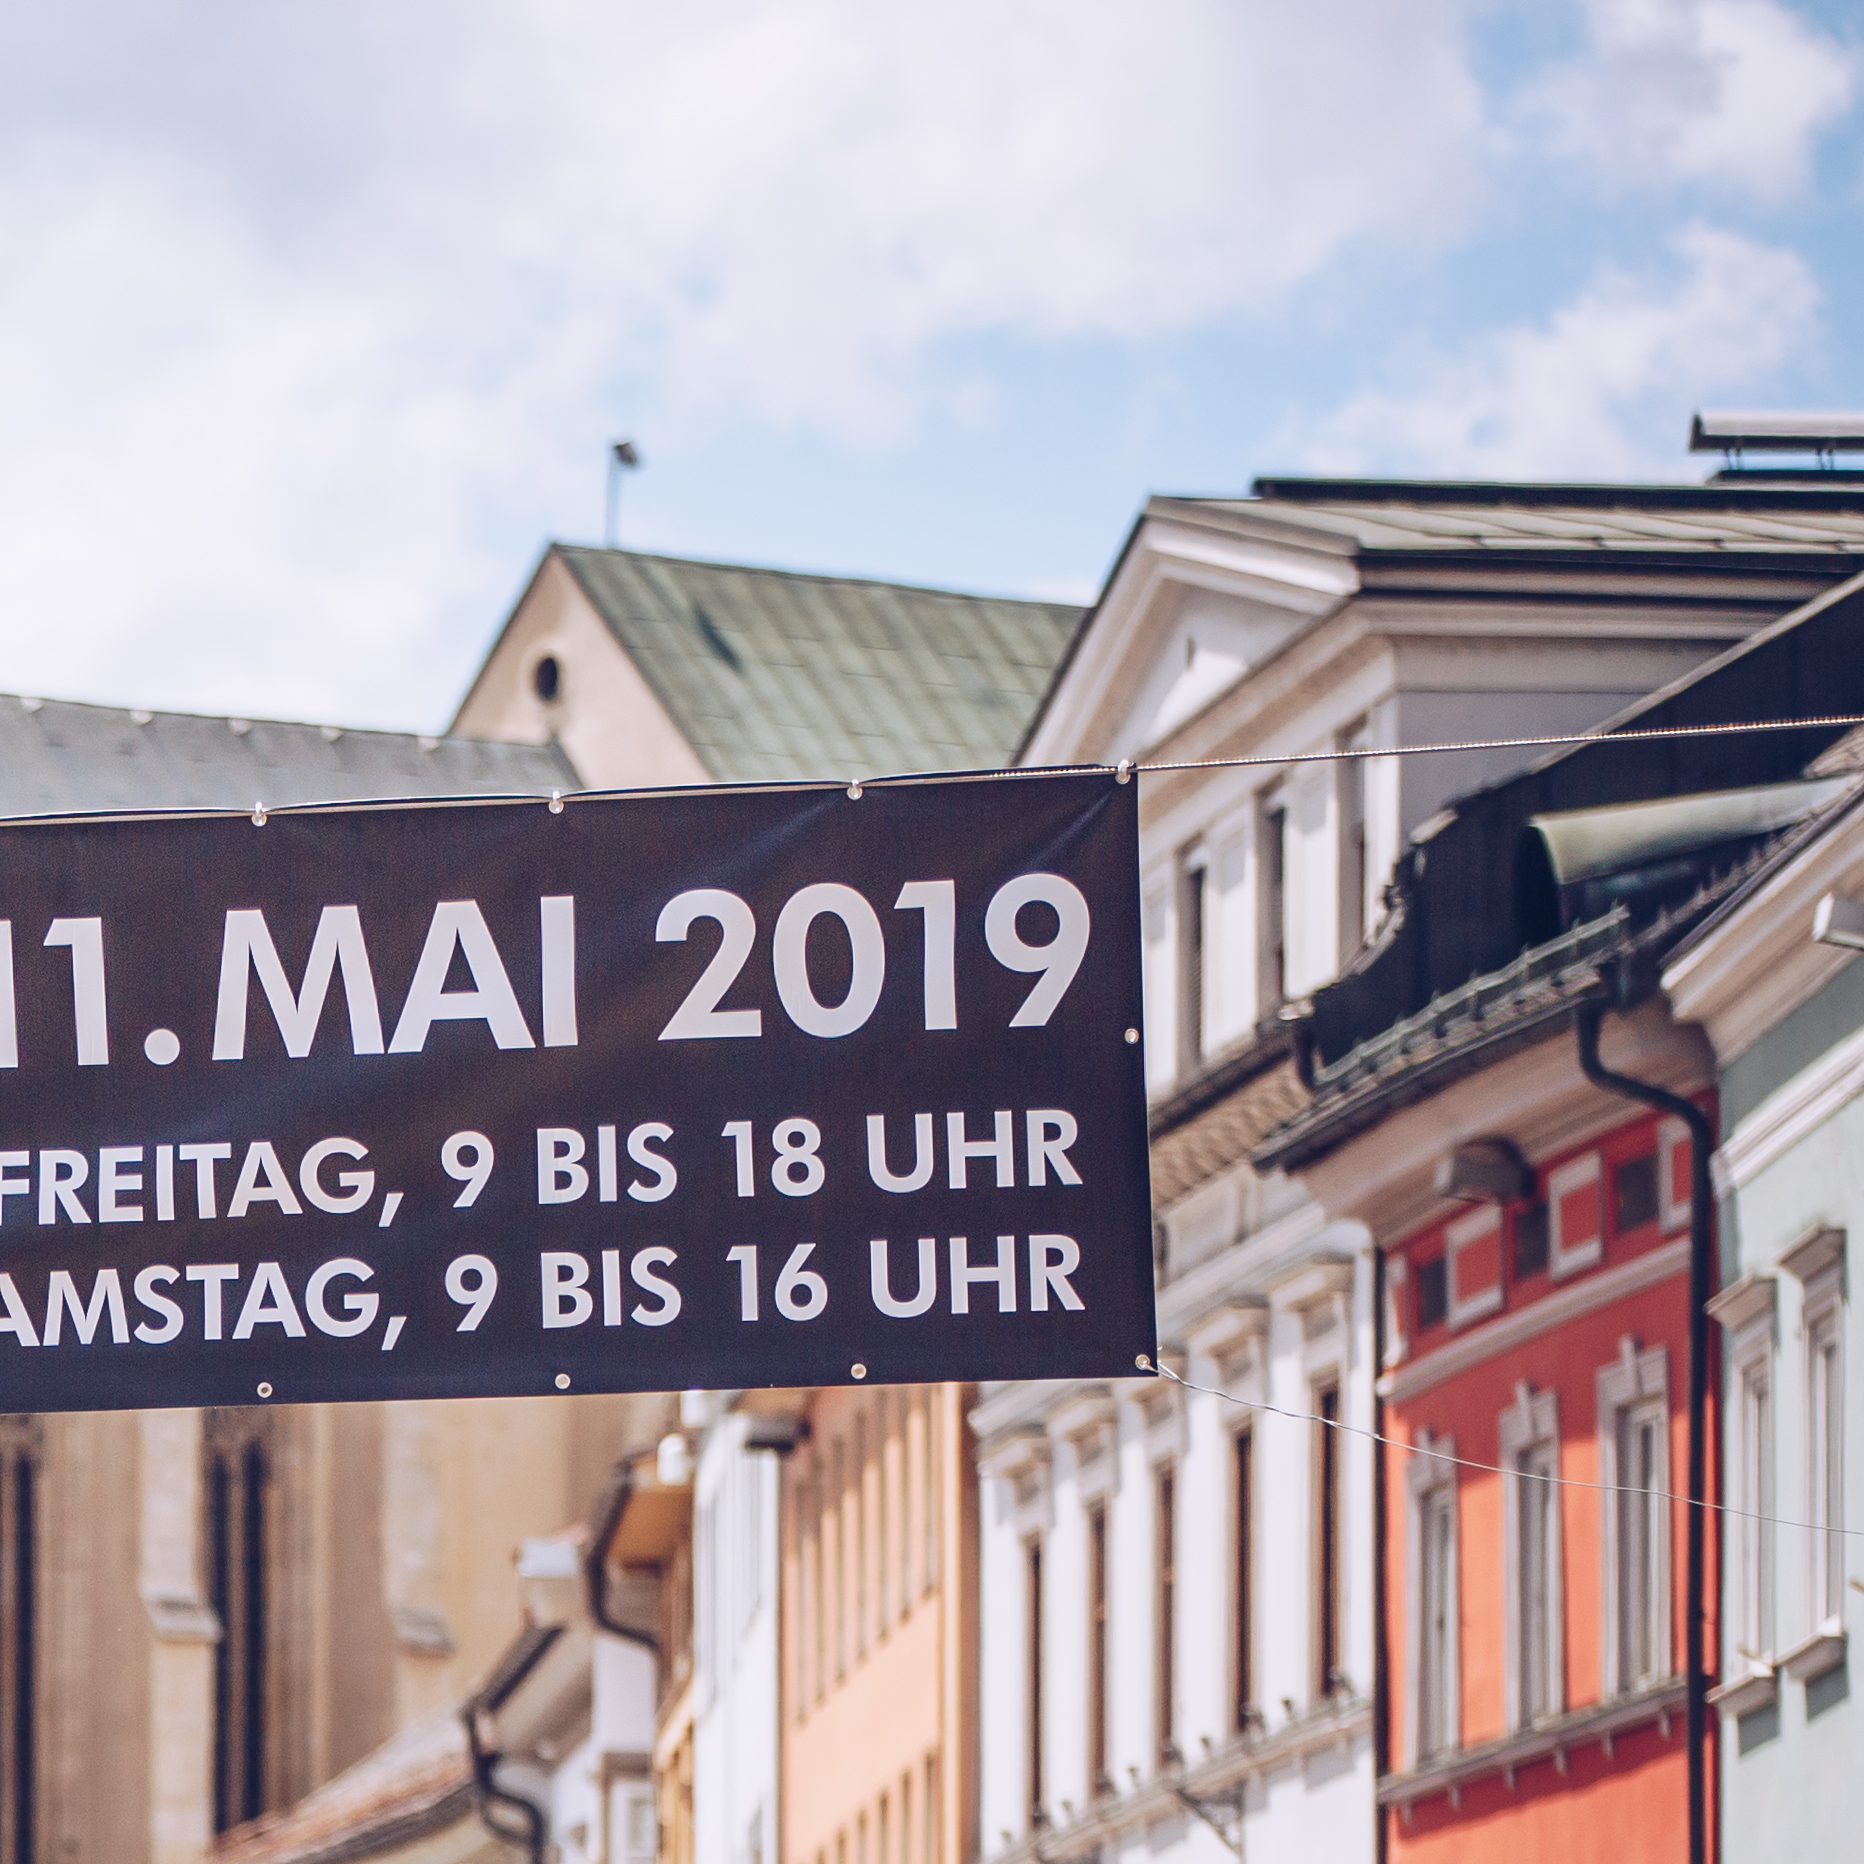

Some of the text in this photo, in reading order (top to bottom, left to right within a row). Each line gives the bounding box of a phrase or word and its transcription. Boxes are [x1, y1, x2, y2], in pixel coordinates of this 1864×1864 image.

[656, 872, 1091, 1041] 2019
[440, 1130, 495, 1208] 9
[536, 1121, 678, 1205] BIS
[720, 1117, 826, 1198] 18
[866, 1109, 1084, 1194] UHR
[444, 1253, 499, 1332] 9
[540, 1246, 682, 1329] BIS
[725, 1242, 829, 1322] 16
[869, 1234, 1086, 1319] UHR
